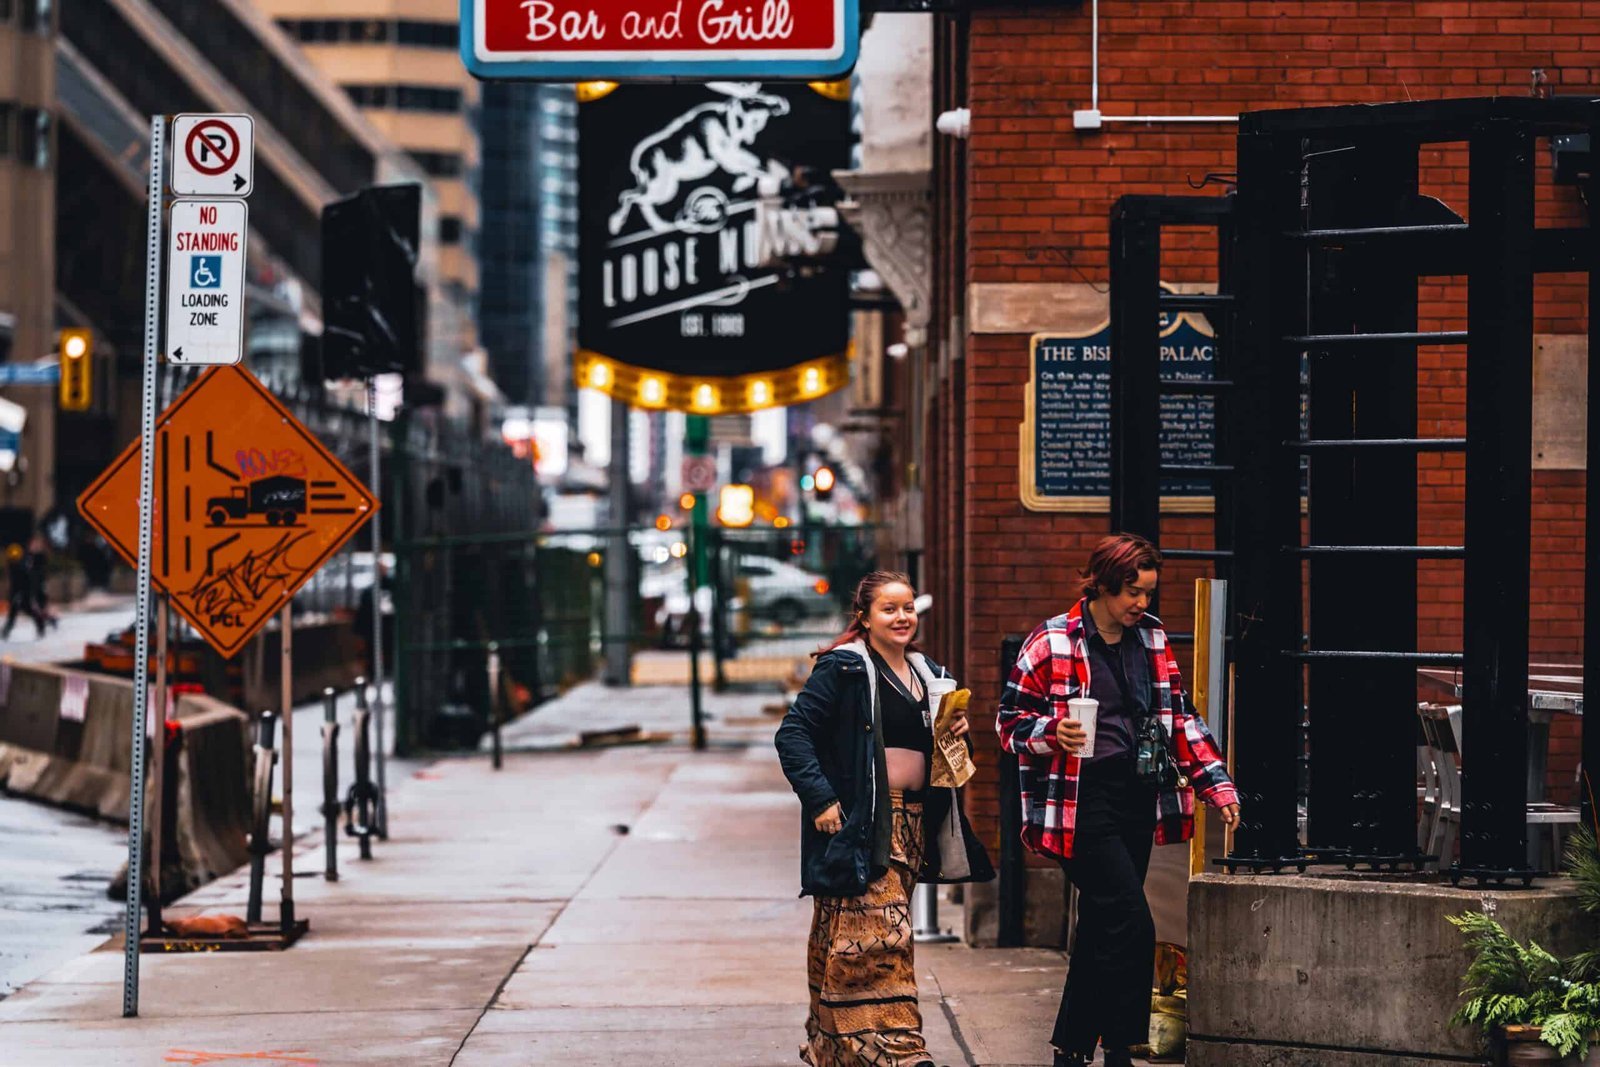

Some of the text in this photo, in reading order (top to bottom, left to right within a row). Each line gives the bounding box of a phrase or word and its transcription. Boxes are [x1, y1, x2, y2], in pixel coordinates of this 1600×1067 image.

[519, 0, 795, 45] Bar and Grill
[199, 206, 218, 225] NO
[176, 232, 239, 252] STANDING
[603, 236, 700, 308] LOOSE
[181, 293, 229, 308] LOADING
[189, 312, 218, 326] ZONE
[1041, 345, 1077, 361] THE
[1159, 345, 1214, 361] PALAC
[210, 613, 246, 628] PCL
